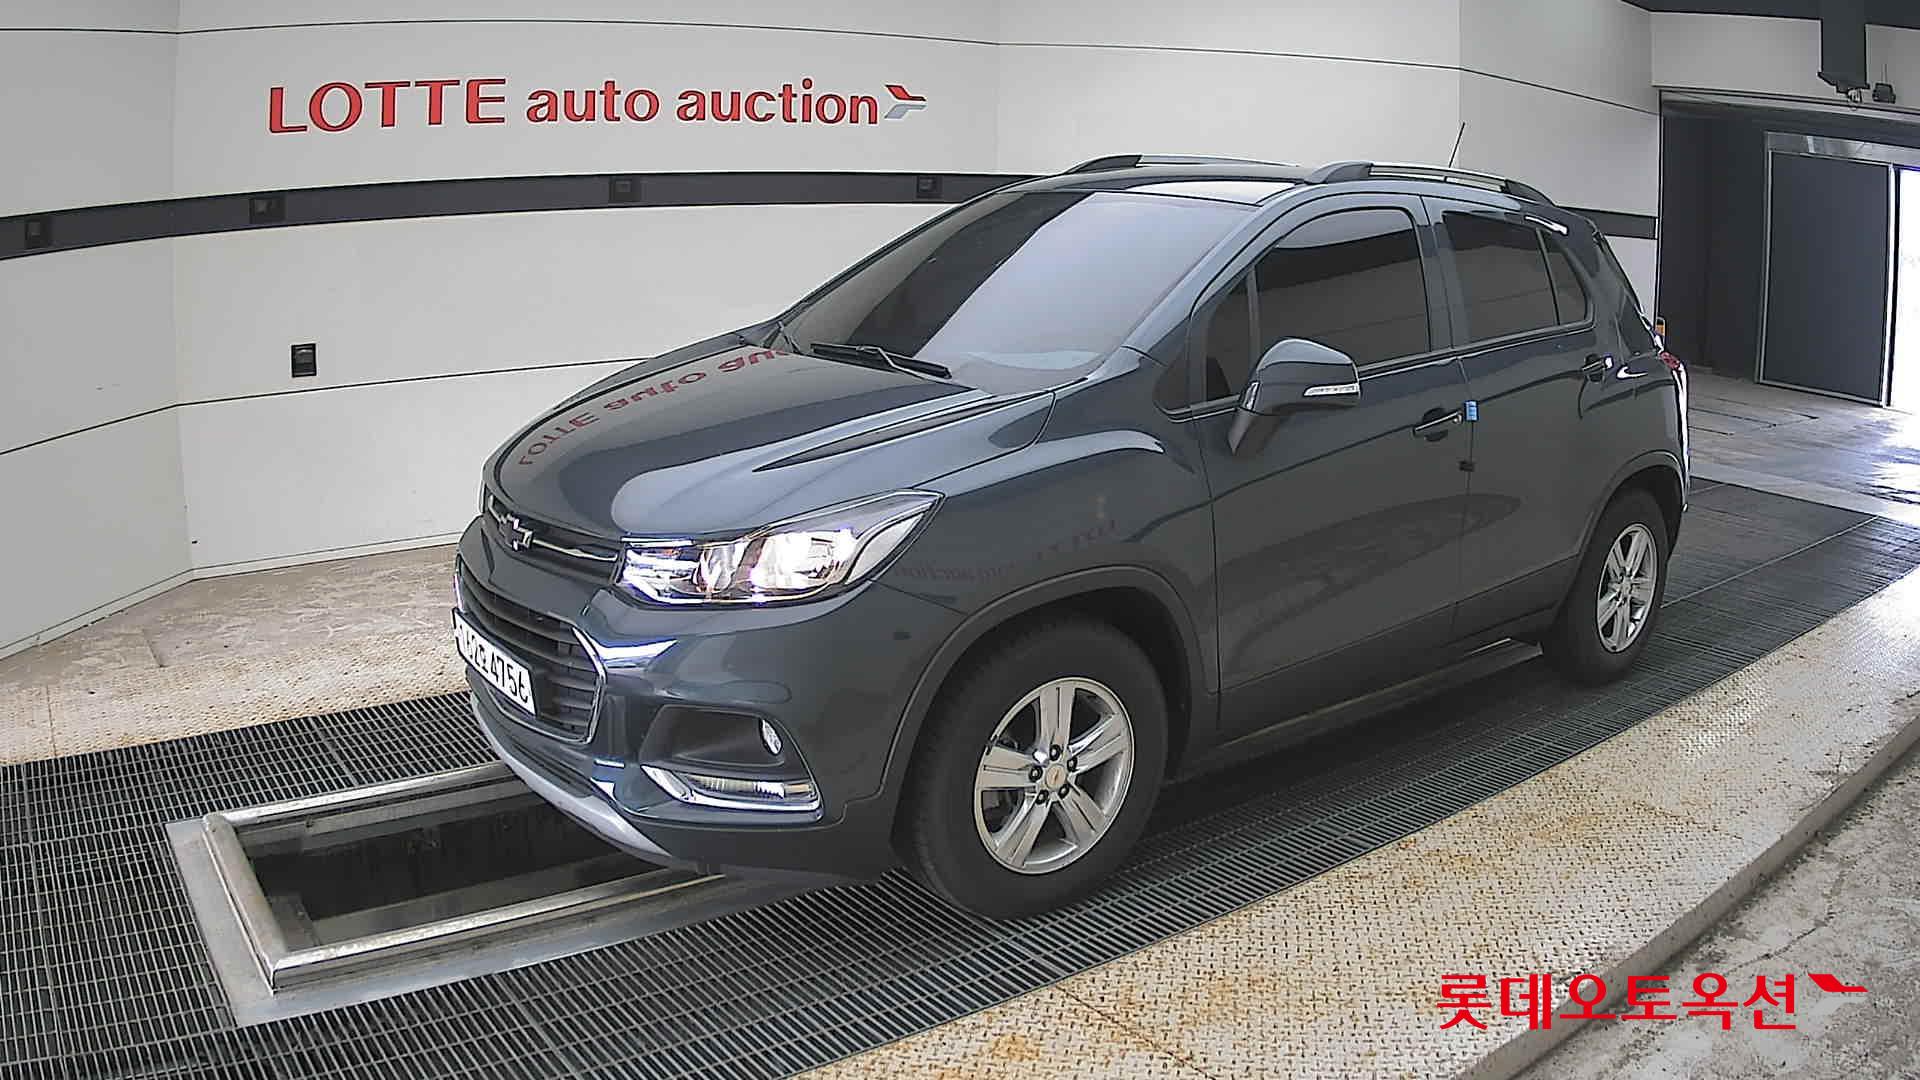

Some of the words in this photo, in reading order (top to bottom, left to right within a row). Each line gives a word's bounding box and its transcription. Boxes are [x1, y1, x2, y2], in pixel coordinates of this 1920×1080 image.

[269, 78, 506, 133] LOTTE
[525, 80, 660, 123] auto
[676, 78, 879, 124] auction
[490, 652, 529, 704] 4756
